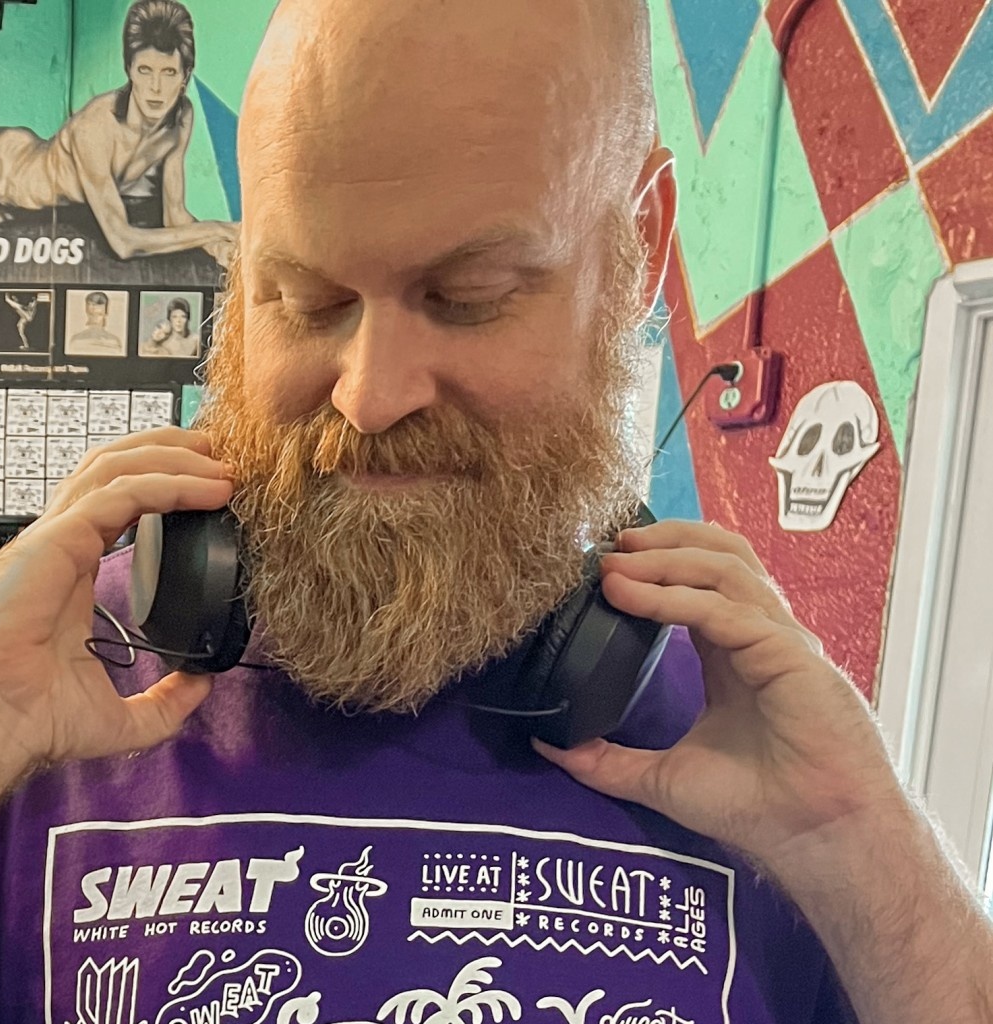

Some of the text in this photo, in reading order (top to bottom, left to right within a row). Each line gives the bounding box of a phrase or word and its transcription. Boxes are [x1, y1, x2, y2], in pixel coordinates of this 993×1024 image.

[14, 236, 85, 265] DOGS
[73, 846, 305, 923] SWEAT
[421, 864, 502, 887] LIVE AT
[535, 857, 655, 917] SWEAT
[422, 907, 503, 921] ADMIT ONE
[538, 914, 645, 942] RECORDS
[672, 887, 690, 949] ALL
[690, 886, 706, 952] AGES
[73, 918, 267, 943] WHITE HOT RECORDS
